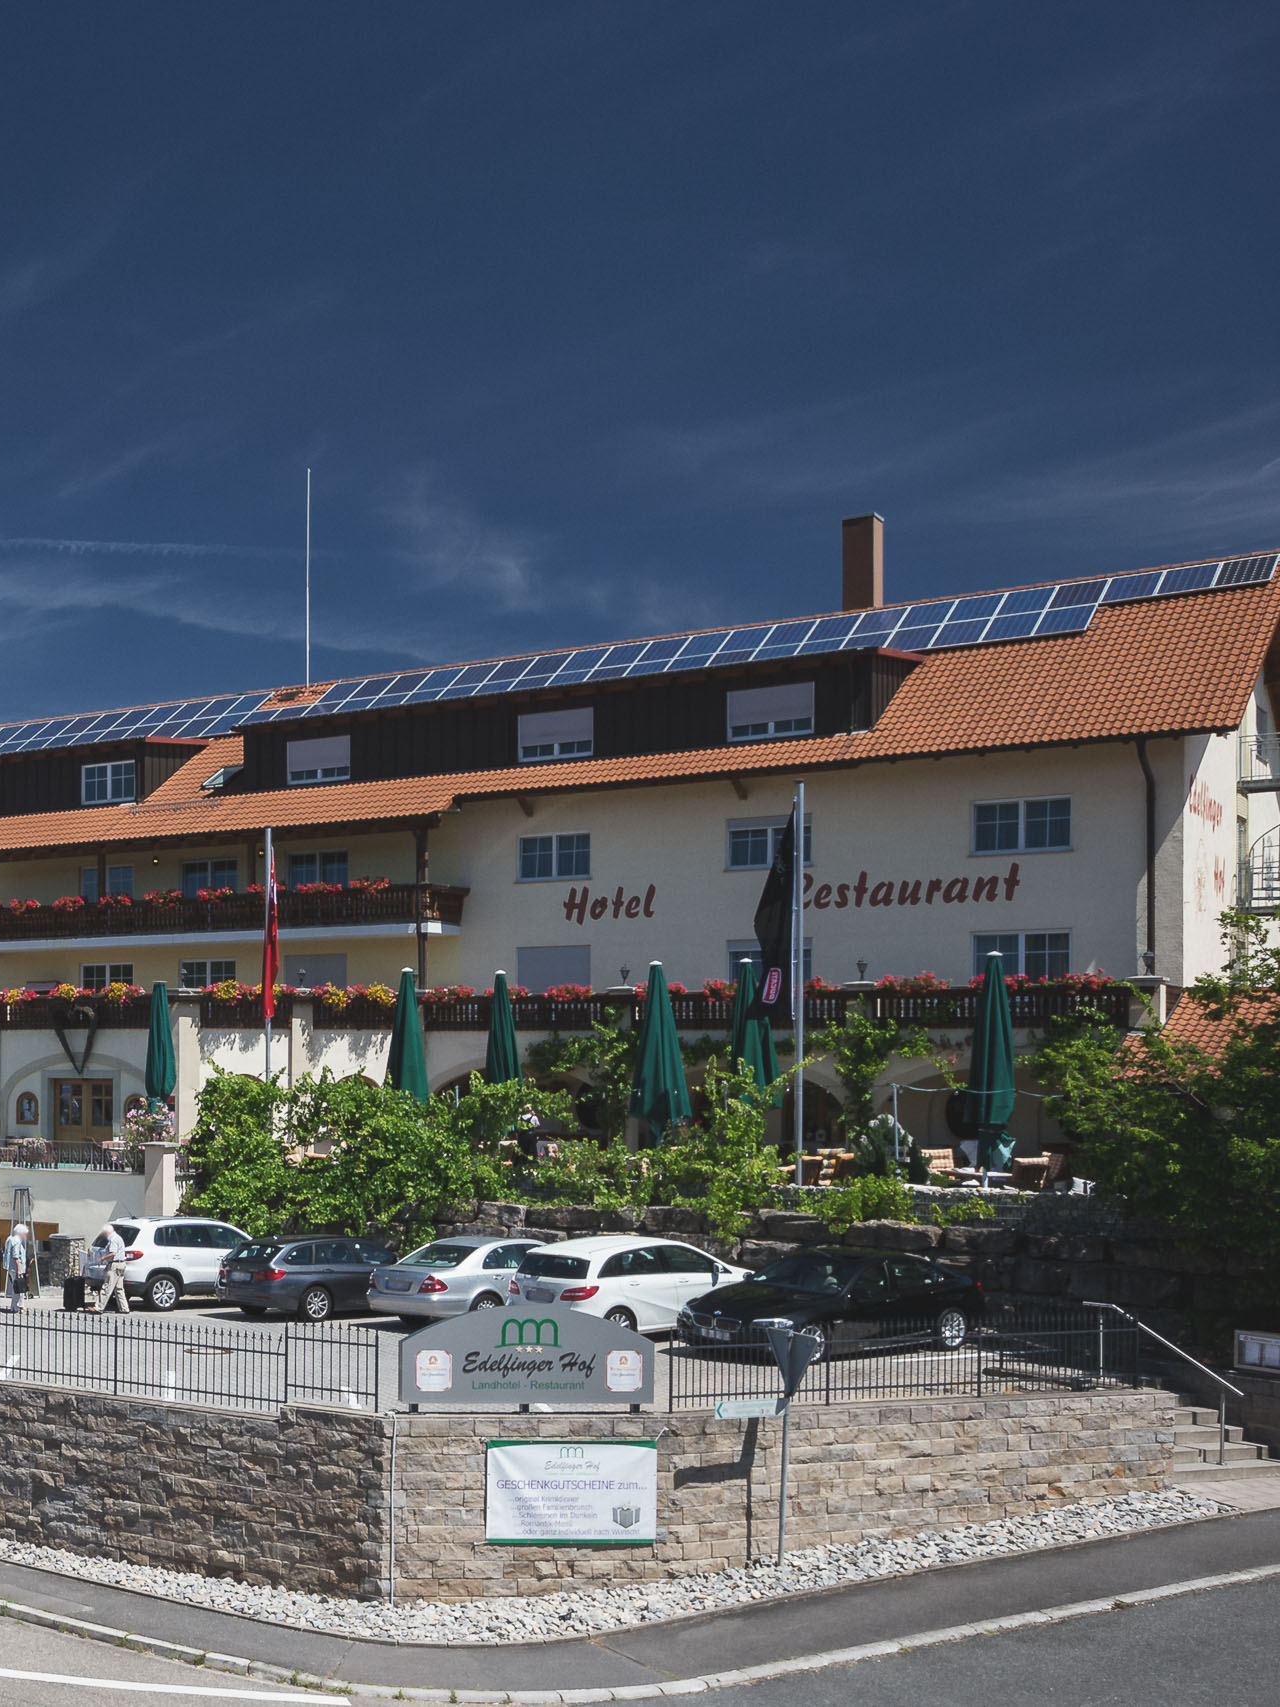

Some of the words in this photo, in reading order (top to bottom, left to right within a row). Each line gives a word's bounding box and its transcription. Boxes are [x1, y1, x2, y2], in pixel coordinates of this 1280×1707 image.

[563, 884, 656, 926] Hotel
[462, 1351, 553, 1378] Edelfinger
[559, 1351, 596, 1378] Hof
[472, 1380, 520, 1390] Landhotel
[530, 1380, 585, 1390] Restaurant
[544, 1460, 583, 1474] Edelfinger
[585, 1461, 601, 1472] Hof
[496, 1480, 615, 1489] GESCHENKGUTSCHEINE
